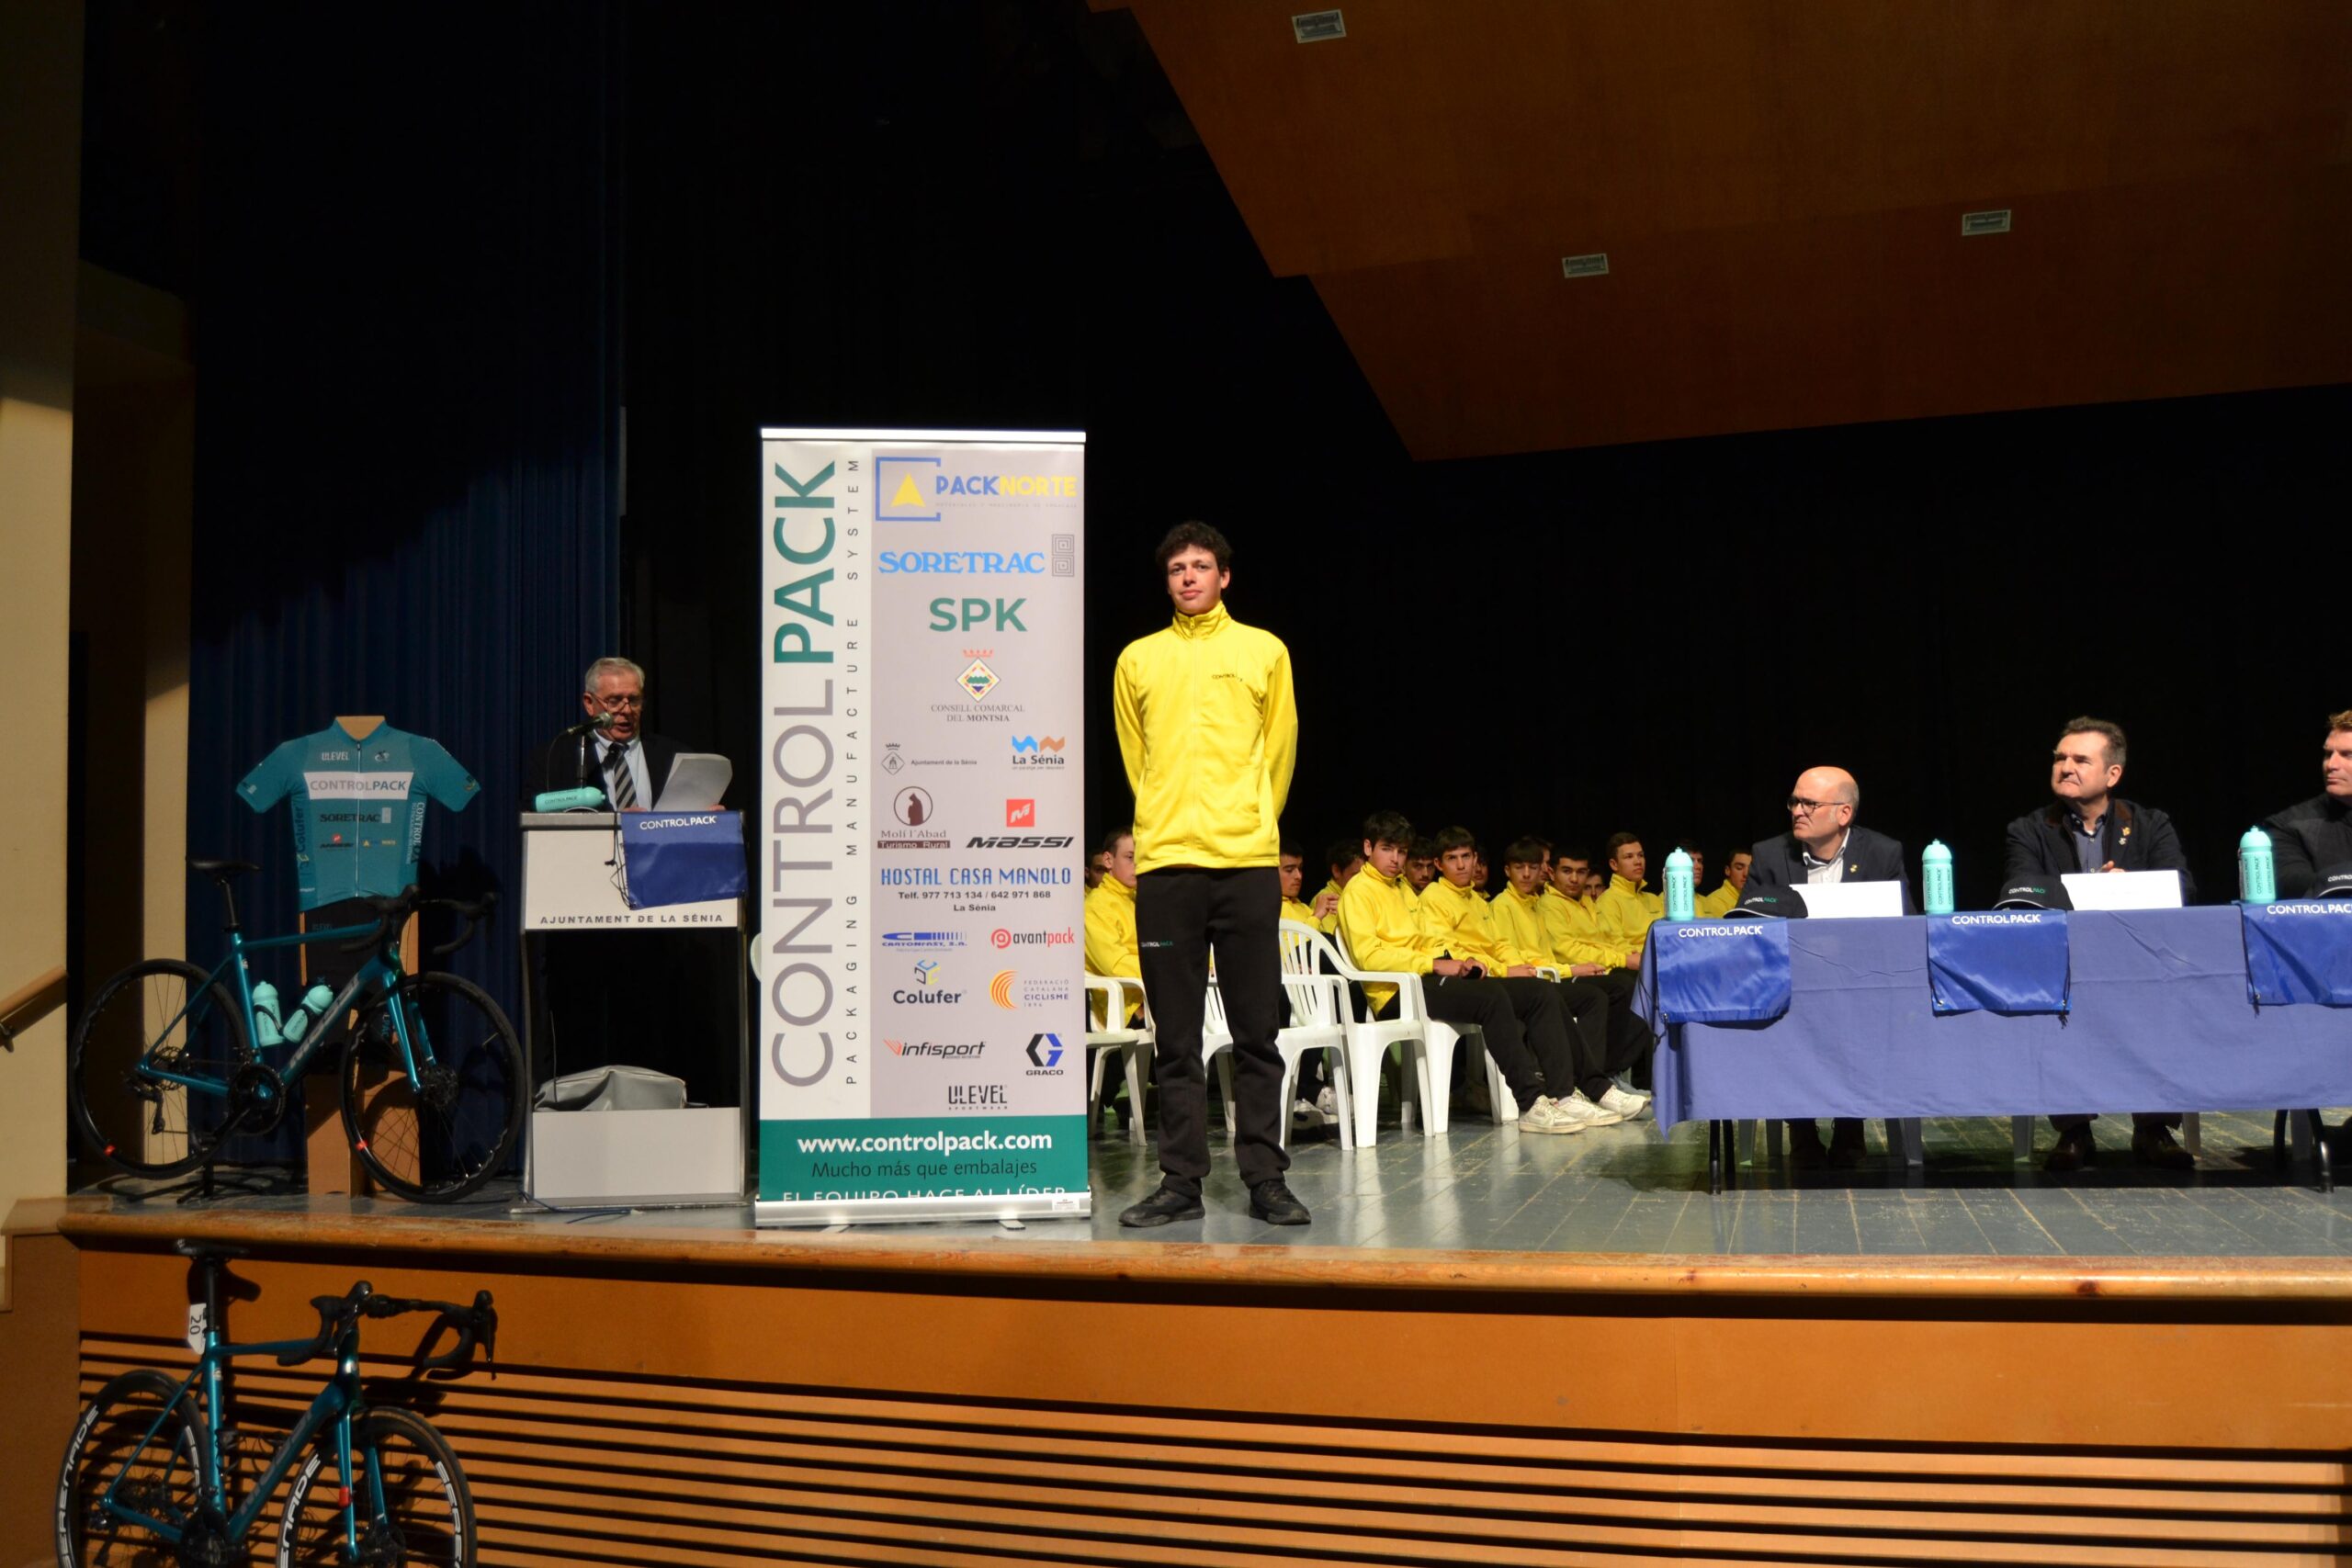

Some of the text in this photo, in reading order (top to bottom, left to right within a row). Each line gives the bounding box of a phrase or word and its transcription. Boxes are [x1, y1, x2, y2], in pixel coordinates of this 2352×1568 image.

[935, 475, 1078, 498] PACKNORTE
[877, 551, 1046, 574] SORETRAC
[929, 597, 1028, 632] SPK
[931, 705, 1025, 713] CONSELL COMARCAL
[1012, 754, 1065, 765] La Sénia
[772, 460, 836, 1087] CONTROLPACK
[846, 460, 859, 1085] PACKAGING MANUFACTURE SYSTEM
[310, 781, 406, 792] CONTROLPACK
[320, 813, 381, 823] SORETRAC
[639, 816, 717, 830] CONTROLPACK
[881, 840, 949, 849] Turismo Rural
[881, 867, 1071, 886] HOSTAL CASA MANOLO
[899, 891, 919, 899] Telf.
[922, 891, 940, 899] 977
[944, 891, 961, 899] 713
[965, 891, 982, 899] 134
[2267, 904, 2352, 914] CONTROLPAC
[540, 916, 631, 924] AJUNTAMENT
[1951, 914, 2041, 925] CONTROLPACK
[1013, 926, 1074, 947] avantpack
[1679, 926, 1763, 938] CONTROLPACK
[893, 990, 961, 1004] Colufer
[901, 1041, 986, 1059] infisport
[797, 1130, 1052, 1156] www.controlpack.com
[810, 1158, 1037, 1179] Mucho más que embalajes
[190, 1315, 201, 1335] 20
